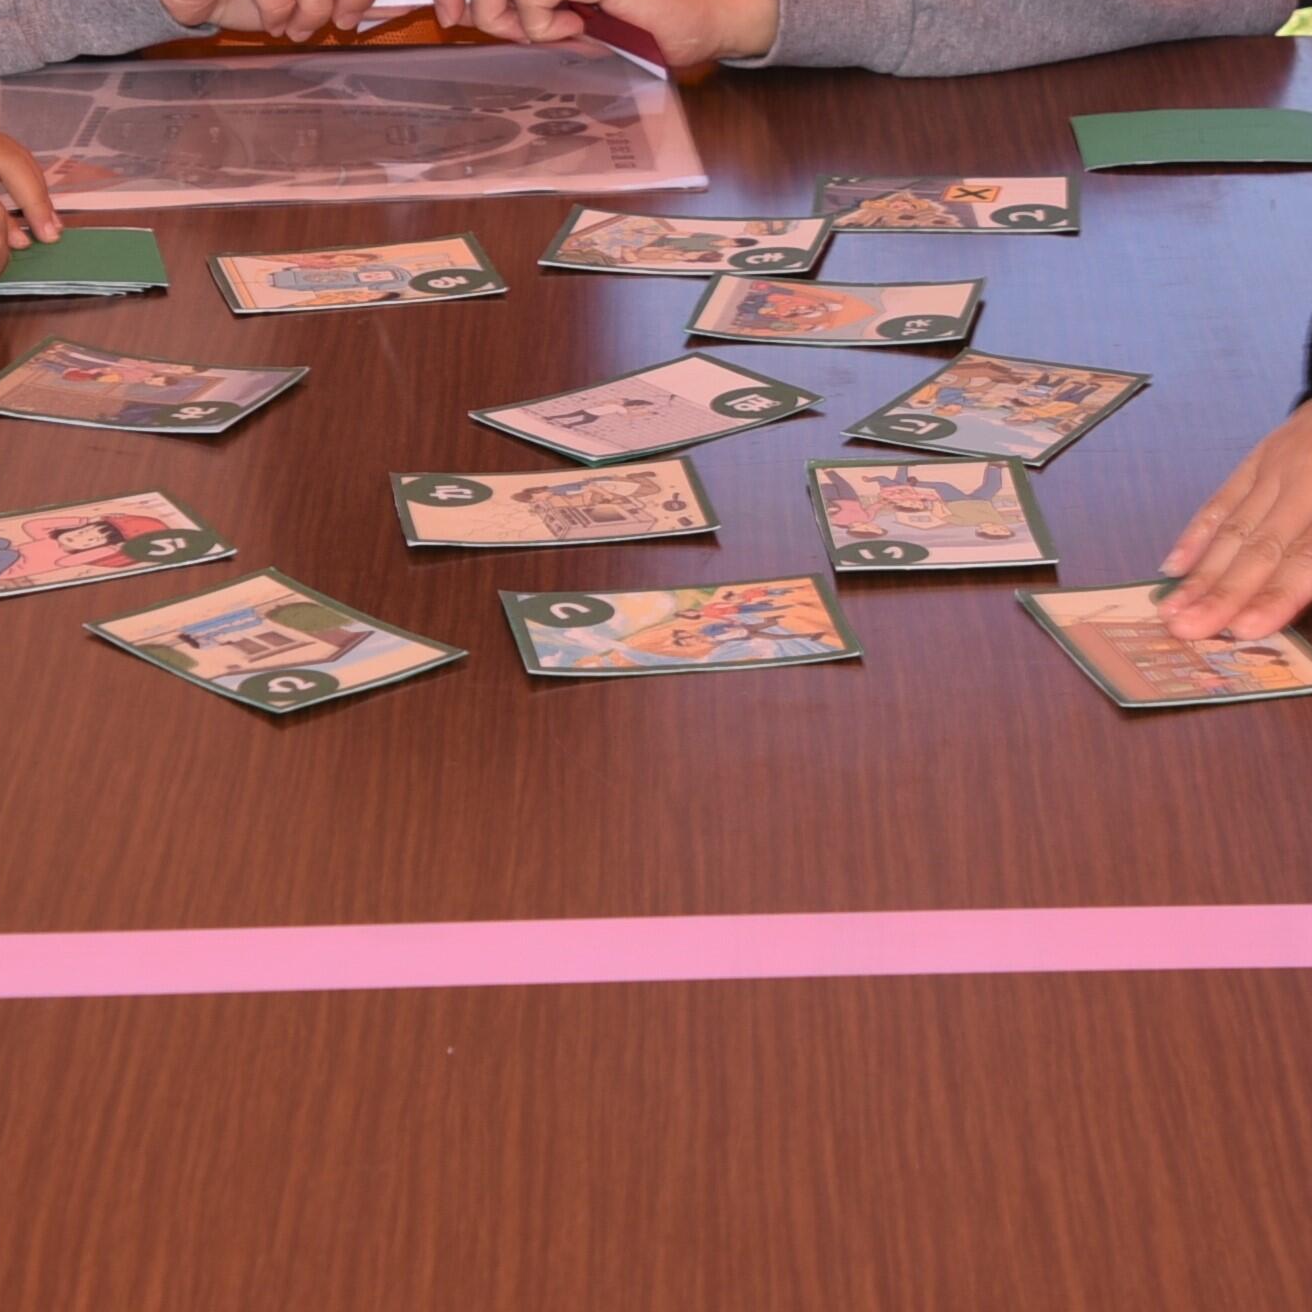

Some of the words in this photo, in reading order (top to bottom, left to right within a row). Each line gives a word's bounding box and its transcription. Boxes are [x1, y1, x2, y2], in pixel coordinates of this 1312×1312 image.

[1008, 209, 1046, 222] て
[745, 252, 785, 265] も
[171, 406, 219, 420] み
[429, 484, 473, 501] か
